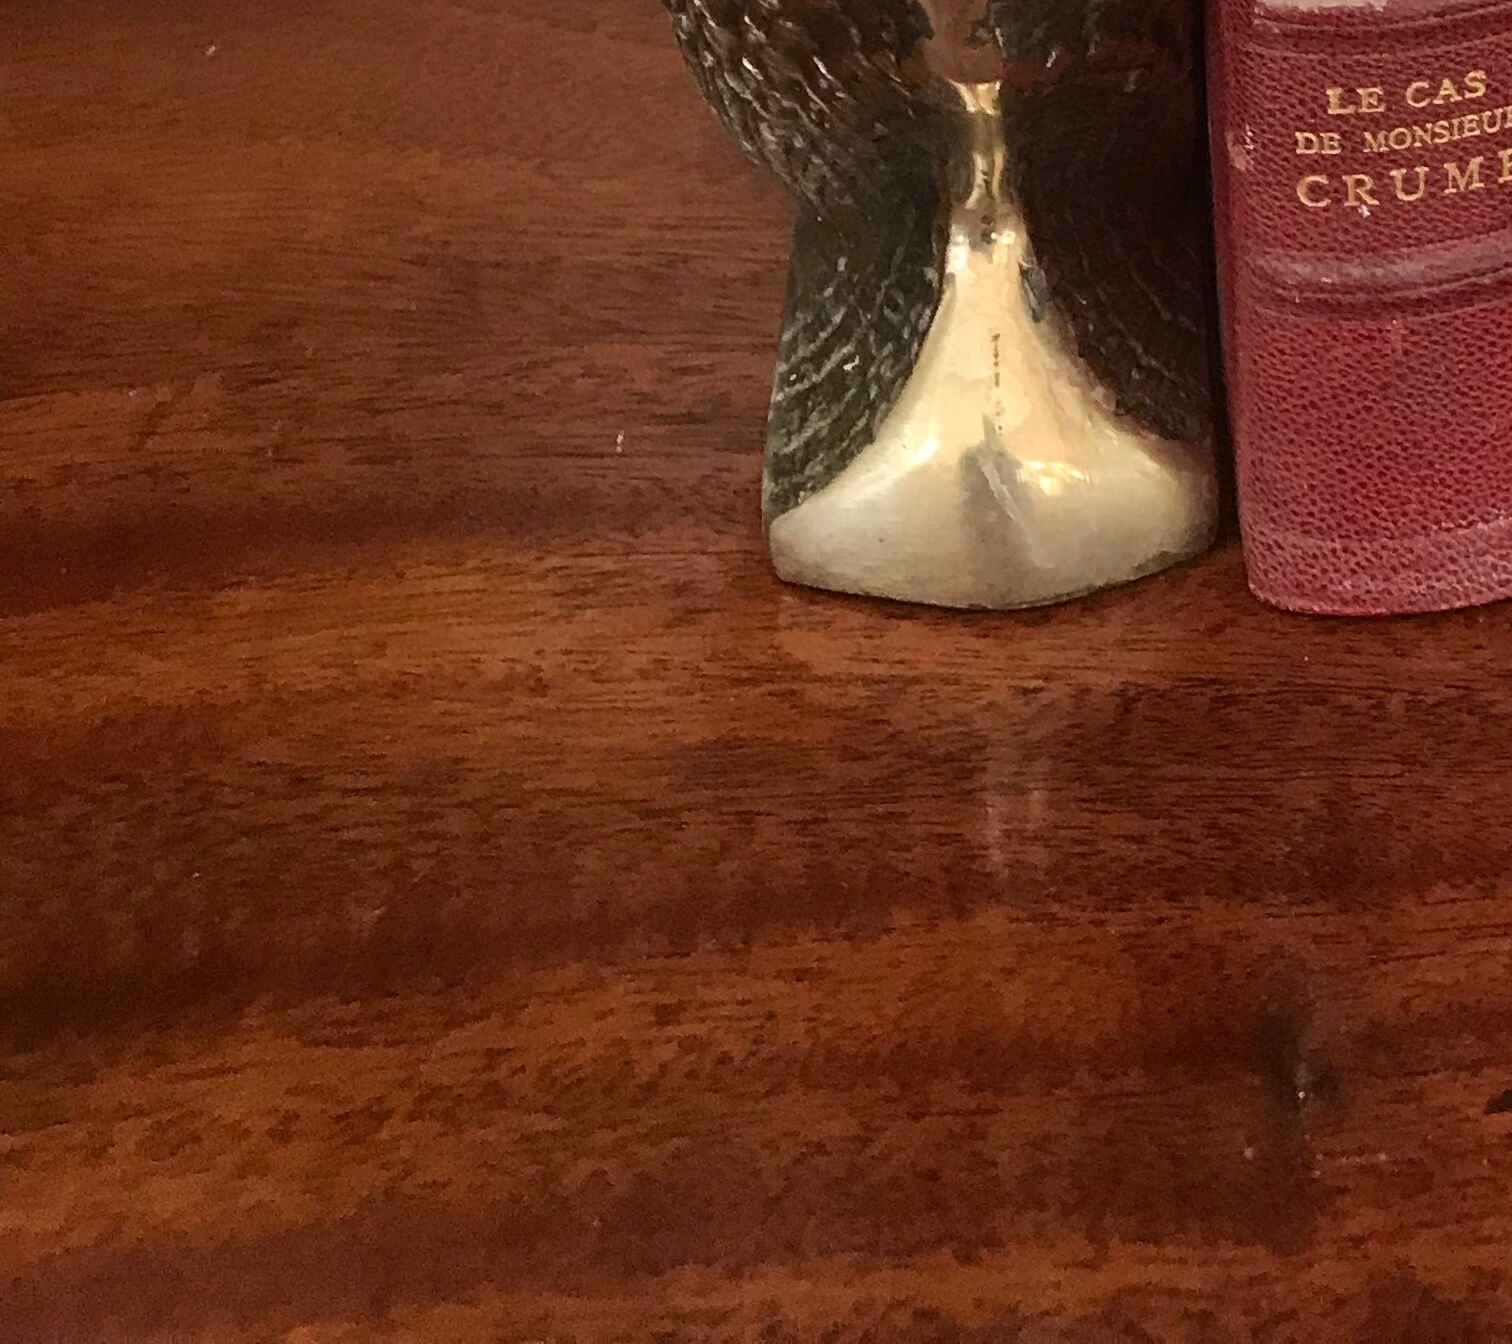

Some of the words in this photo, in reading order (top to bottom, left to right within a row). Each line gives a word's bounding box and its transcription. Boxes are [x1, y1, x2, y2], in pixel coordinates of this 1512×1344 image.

[1326, 86, 1385, 116] LE
[1405, 69, 1488, 109] CAS
[1295, 130, 1342, 156] DE
